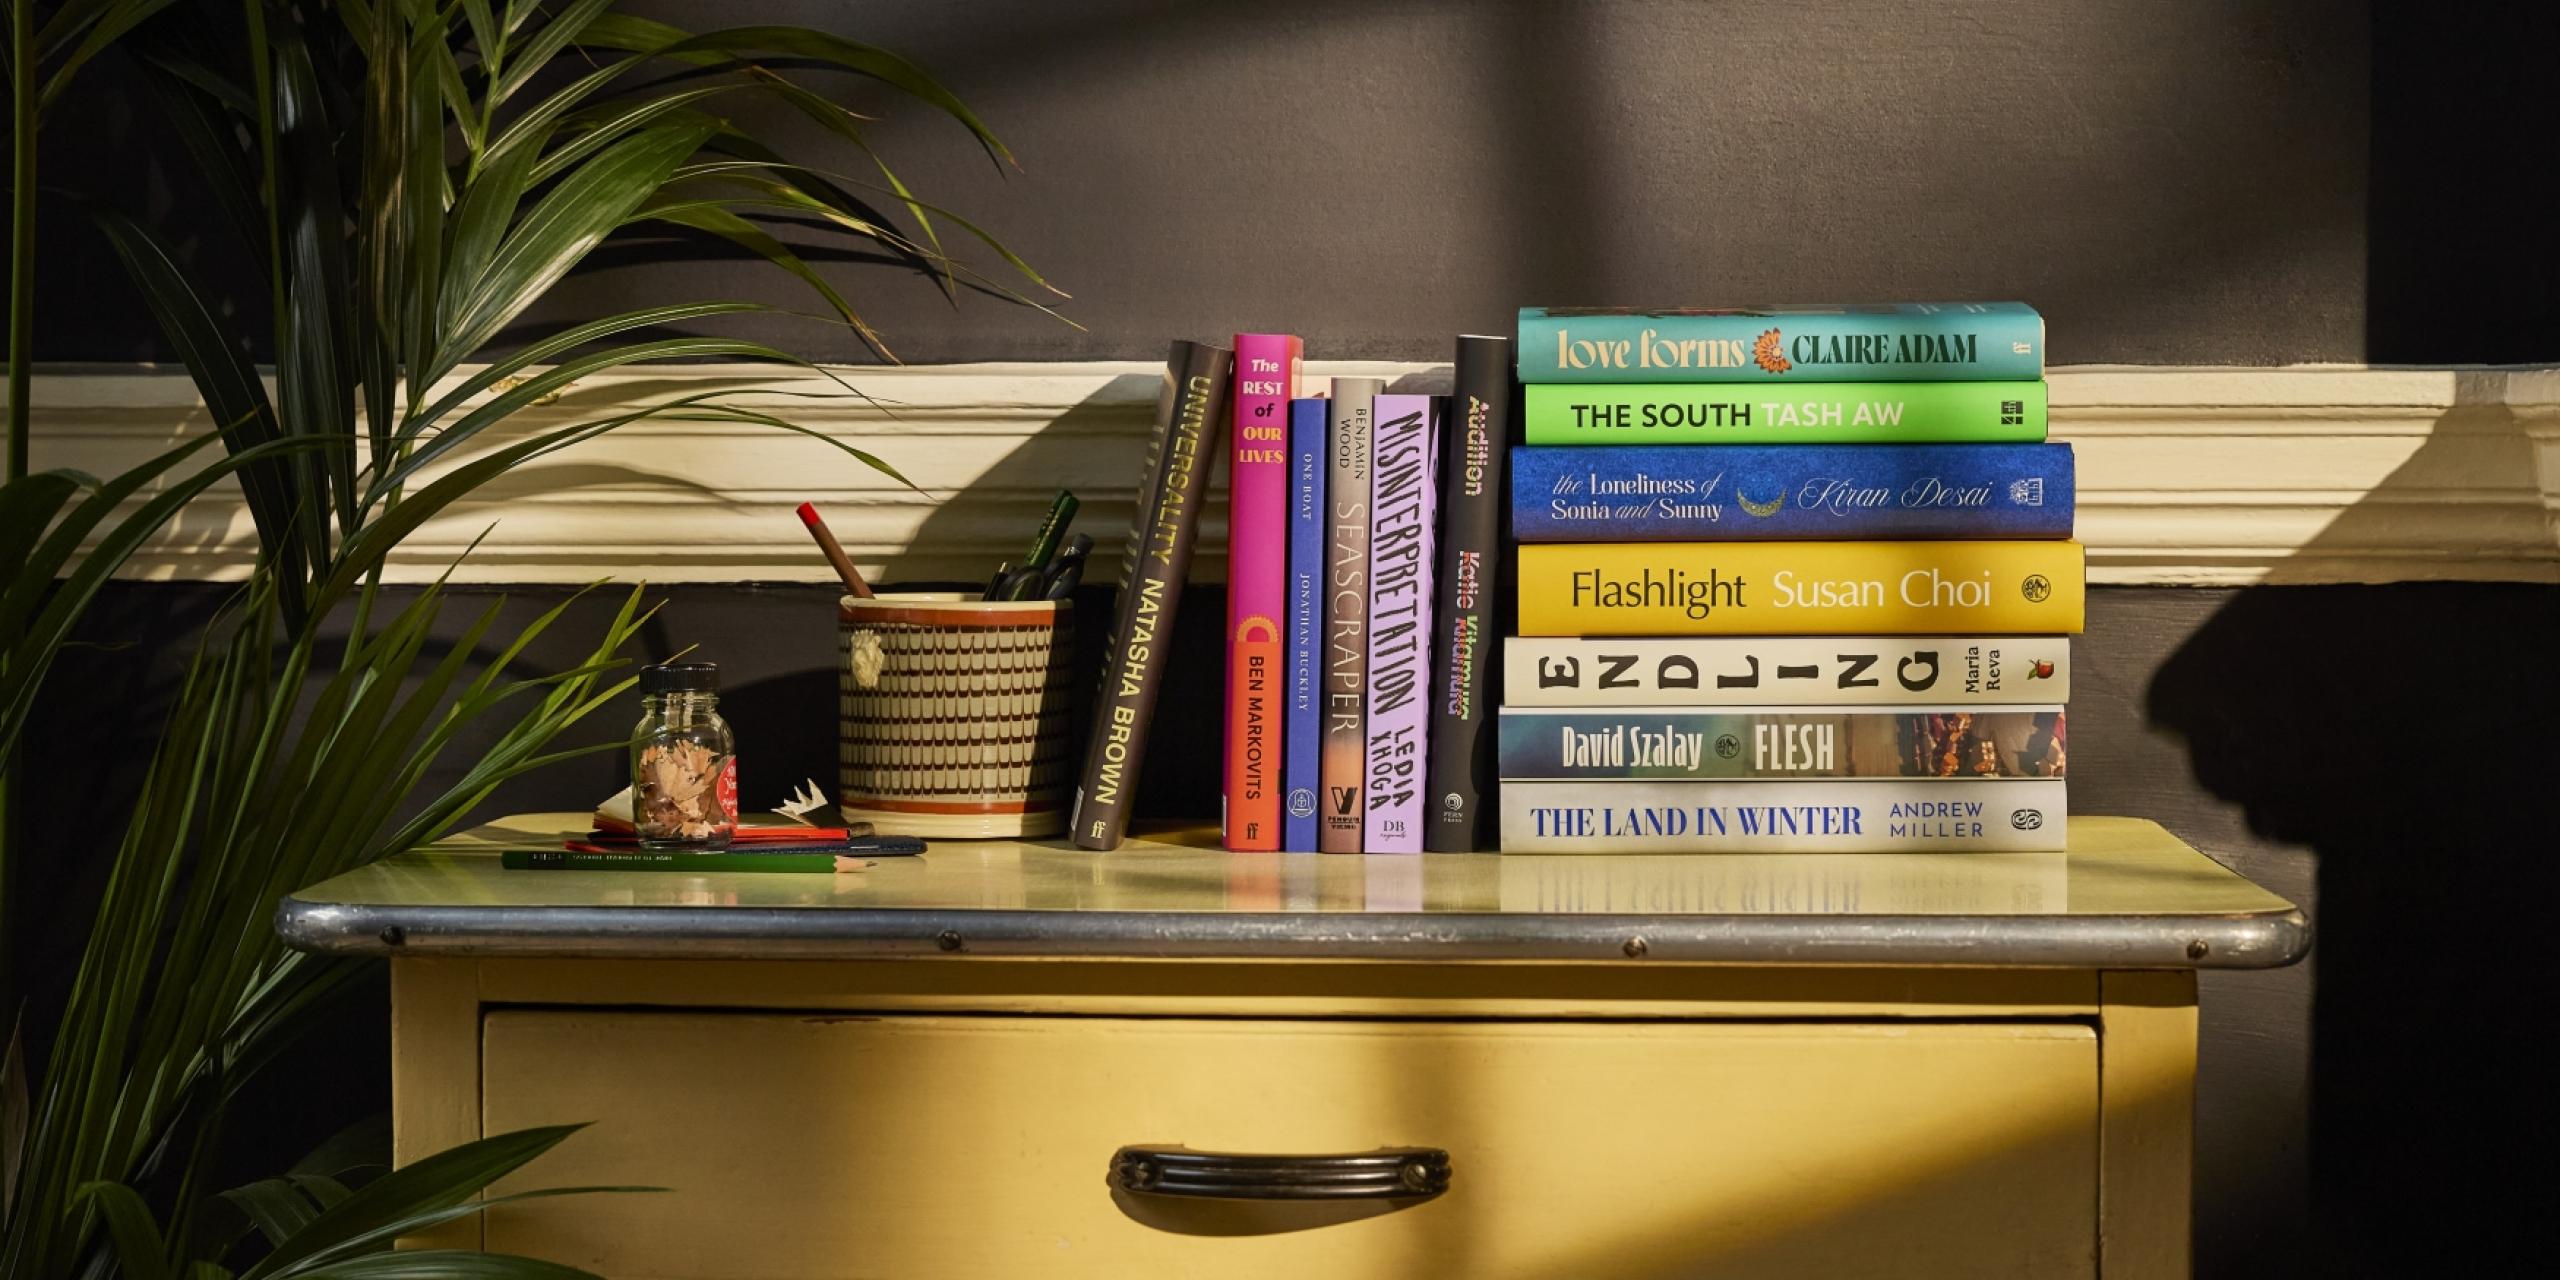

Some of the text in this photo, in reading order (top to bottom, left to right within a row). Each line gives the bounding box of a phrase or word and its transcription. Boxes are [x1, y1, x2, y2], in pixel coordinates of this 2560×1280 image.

[1251, 359, 1279, 373] The
[1557, 328, 1746, 370] love forms
[1791, 333, 1977, 365] CLAIRE ADAM
[1242, 381, 1284, 395] REST
[1254, 403, 1275, 417] of
[1242, 426, 1282, 441] OUR
[1571, 401, 1904, 429] THE SOUTH TASH AW
[1239, 449, 1284, 464] LIVES
[1339, 419, 1351, 469] WOOD
[1354, 408, 1367, 480] BENJAMIN
[1302, 453, 1313, 521] ONE BOAT
[1552, 472, 1726, 500] the Loneliness of
[1798, 477, 1994, 518] Kiran Desai
[1551, 499, 1724, 524] Sonia and Sunny
[1372, 410, 1423, 716] MISINTERPRETATION
[1456, 550, 1480, 609] Katie
[1095, 375, 1212, 805] UNIVERSALITY NATASHA BROWN
[1572, 569, 1992, 620] Flashlight Susan Choi
[1331, 503, 1365, 734] SEASCRAPER
[1298, 573, 1310, 711] JONATHAN BUCKLEY
[1538, 649, 1940, 693] ENDLING
[1965, 646, 1980, 694] Maria
[1986, 648, 2001, 692] Reva
[1245, 656, 1264, 801] BEN MARKOVITS
[1562, 724, 1703, 773] David Szalay
[1755, 724, 1835, 771] FLESH
[1369, 730, 1393, 811] XHOGA
[1392, 725, 1416, 808] LEDIA
[1531, 805, 1864, 838] THE LAND IN WINTER
[1890, 802, 1984, 818] ANDREW
[1890, 822, 1984, 838] MILLER
